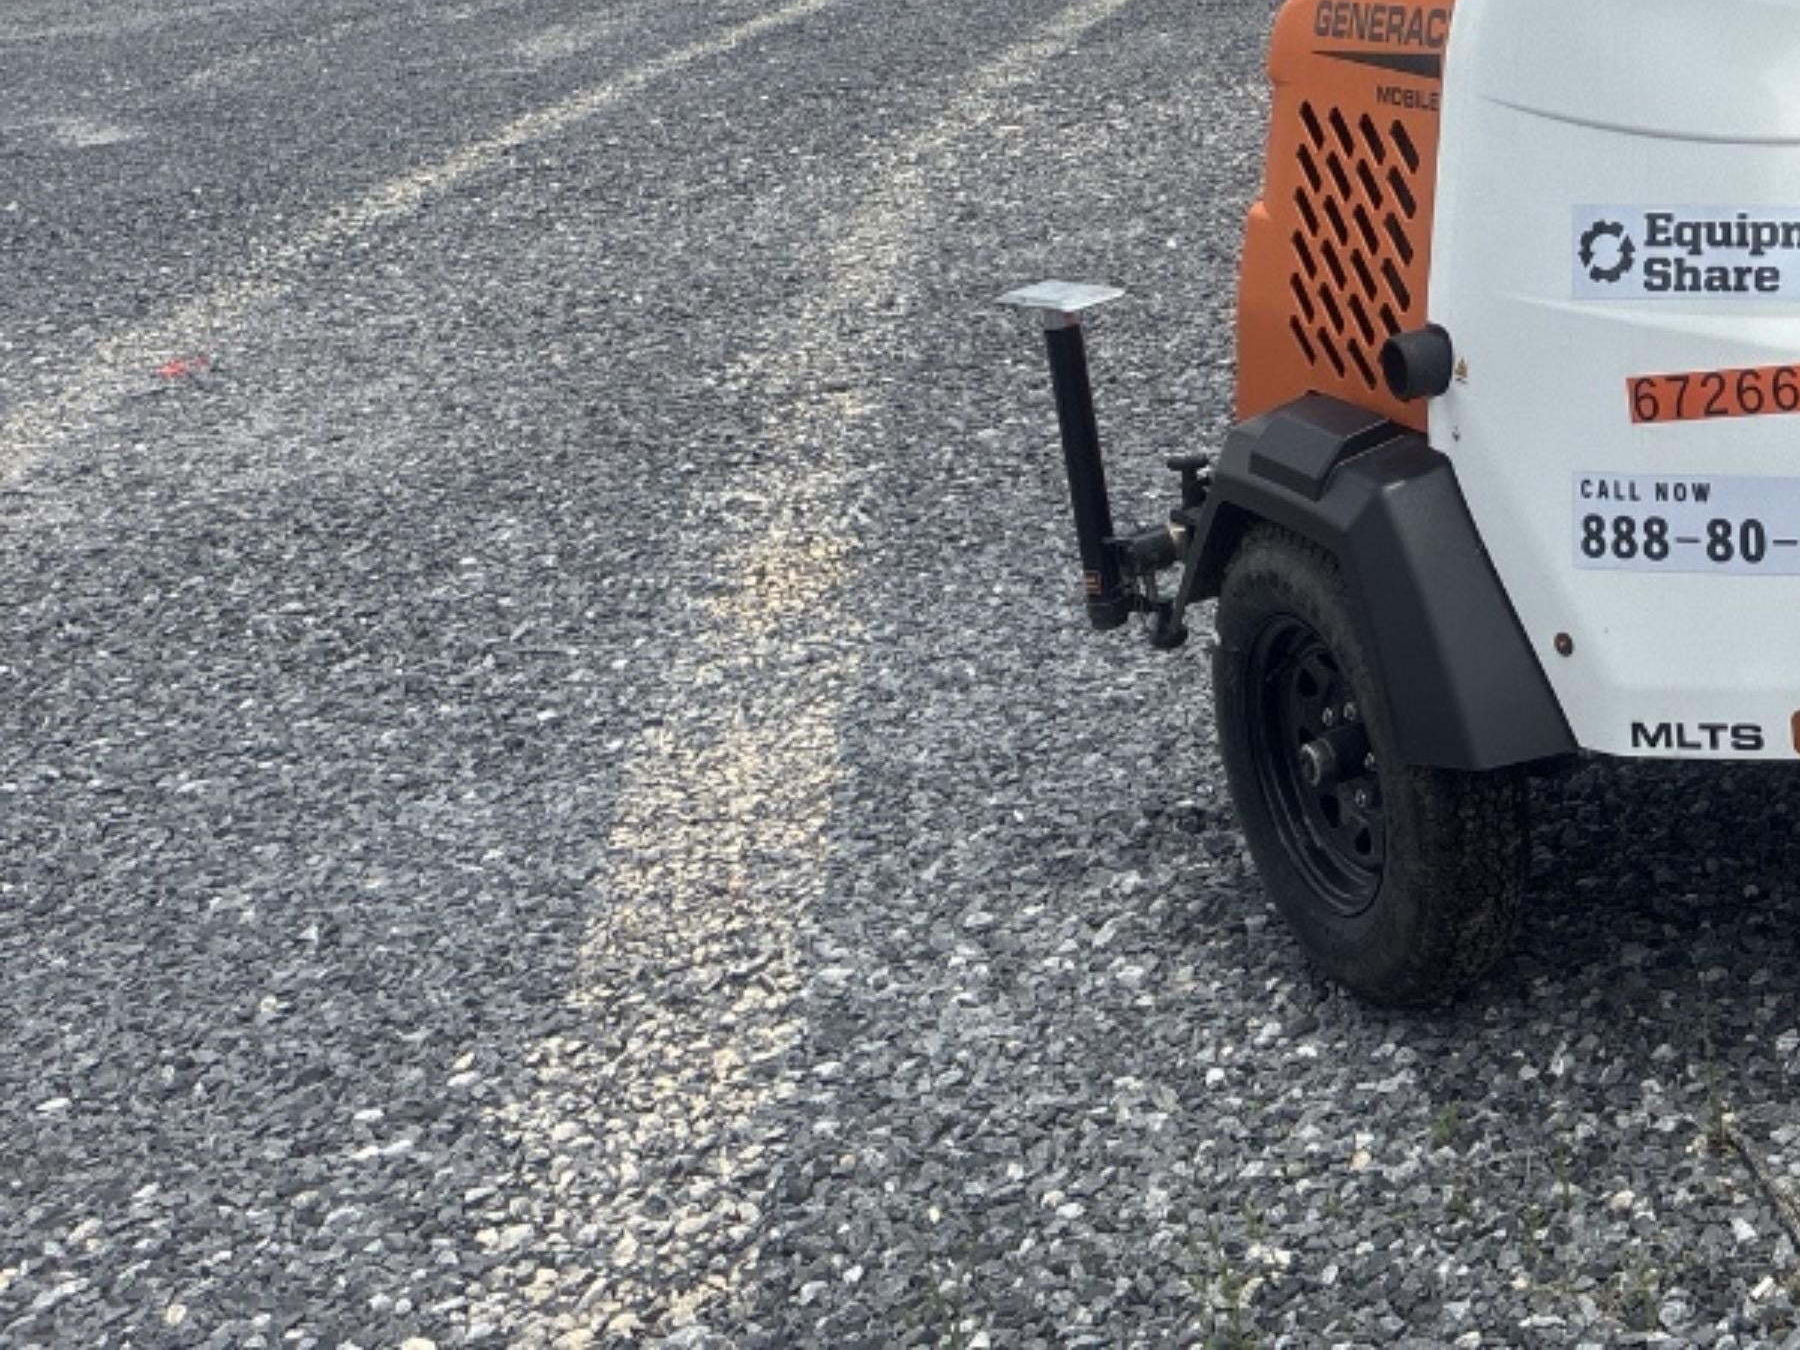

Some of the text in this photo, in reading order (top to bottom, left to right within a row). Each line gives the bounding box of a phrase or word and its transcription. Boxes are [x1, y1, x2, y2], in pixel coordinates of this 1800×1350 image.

[1314, 0, 1449, 48] GENERAC
[1376, 84, 1440, 112] MOBILE
[1643, 257, 1781, 293] Share
[1580, 479, 1712, 503] CALL NOW
[1630, 721, 1765, 751] MLTS
